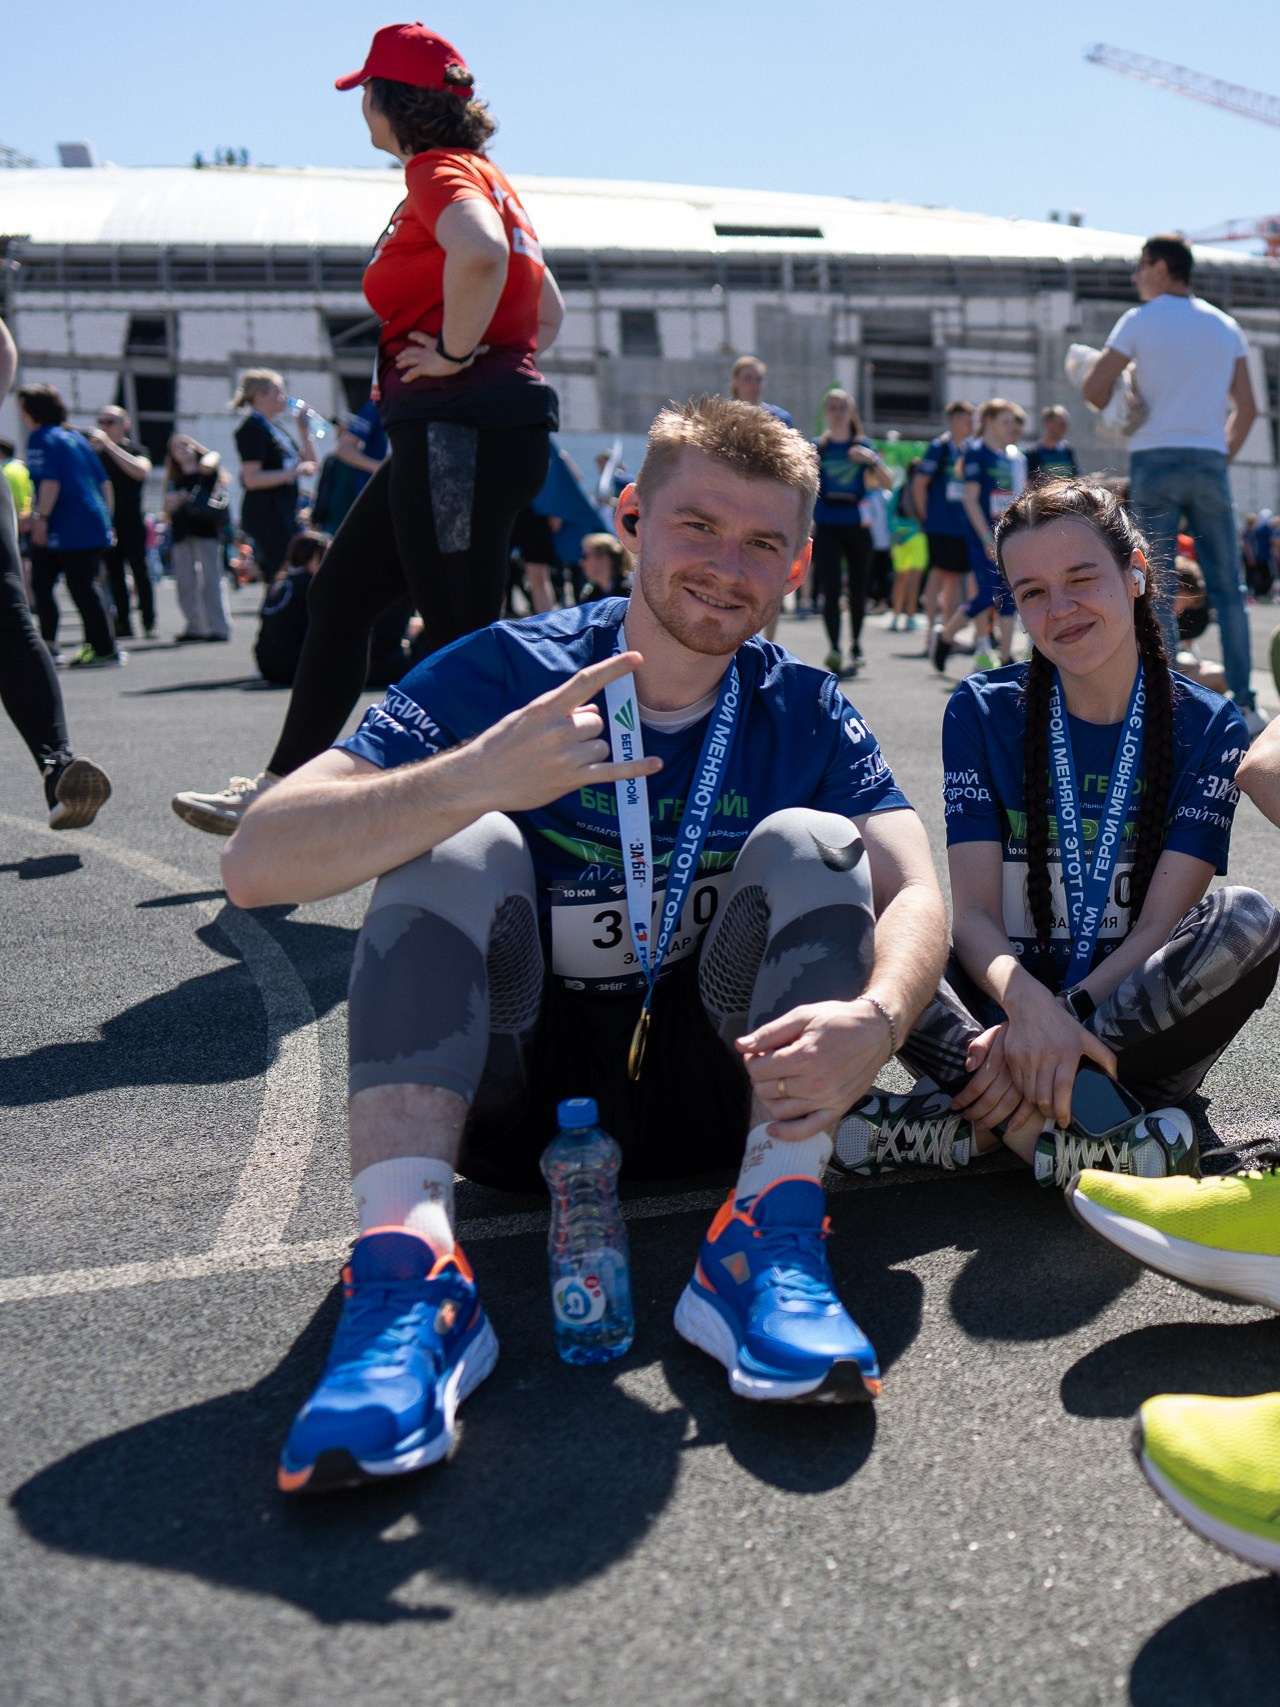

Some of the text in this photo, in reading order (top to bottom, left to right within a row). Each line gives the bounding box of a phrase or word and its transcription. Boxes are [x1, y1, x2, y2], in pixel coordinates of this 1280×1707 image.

[723, 666, 739, 721] ЕРОИ
[1049, 685, 1065, 744] ГЕРОИ
[691, 722, 730, 821] МЕНЯЮТ
[1053, 748, 1077, 832] МЕНЯЮТ
[1107, 731, 1139, 818] МЕНЯЮТ
[677, 823, 702, 884] ЭТОТ
[1064, 836, 1083, 891] ЭТОТ
[1092, 818, 1119, 881] ГЕРОИ
[563, 889, 596, 897] 10 КМ
[1081, 906, 1099, 937] КМ
[1076, 941, 1090, 960] 10
